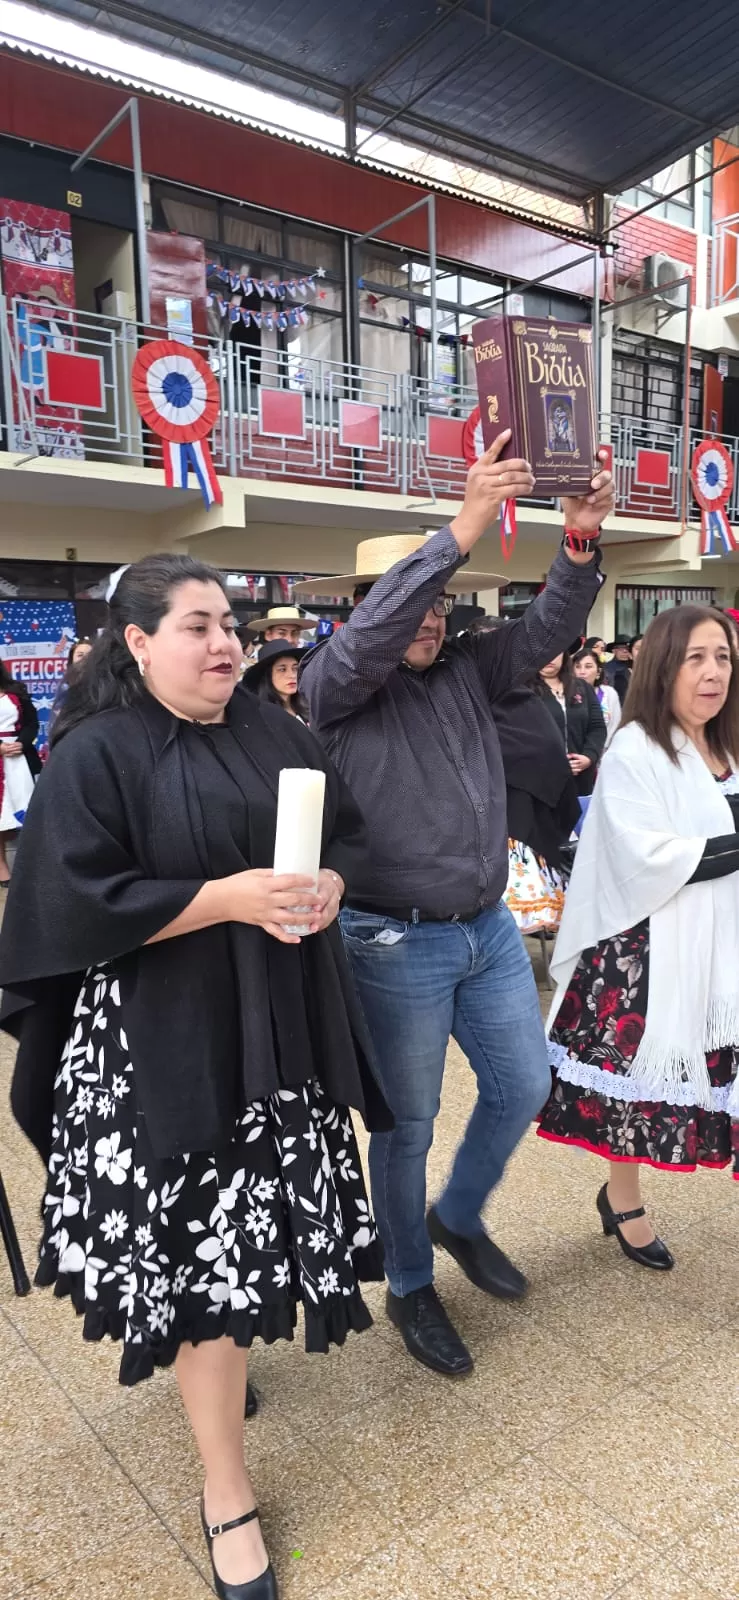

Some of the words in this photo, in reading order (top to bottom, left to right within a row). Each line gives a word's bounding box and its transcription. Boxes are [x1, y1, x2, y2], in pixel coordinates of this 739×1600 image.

[70, 193, 81, 205] 02
[474, 343, 503, 364] Biblia
[542, 341, 568, 354] SAGRADA
[524, 341, 587, 388] Biblia
[24, 681, 57, 694] IESTA
